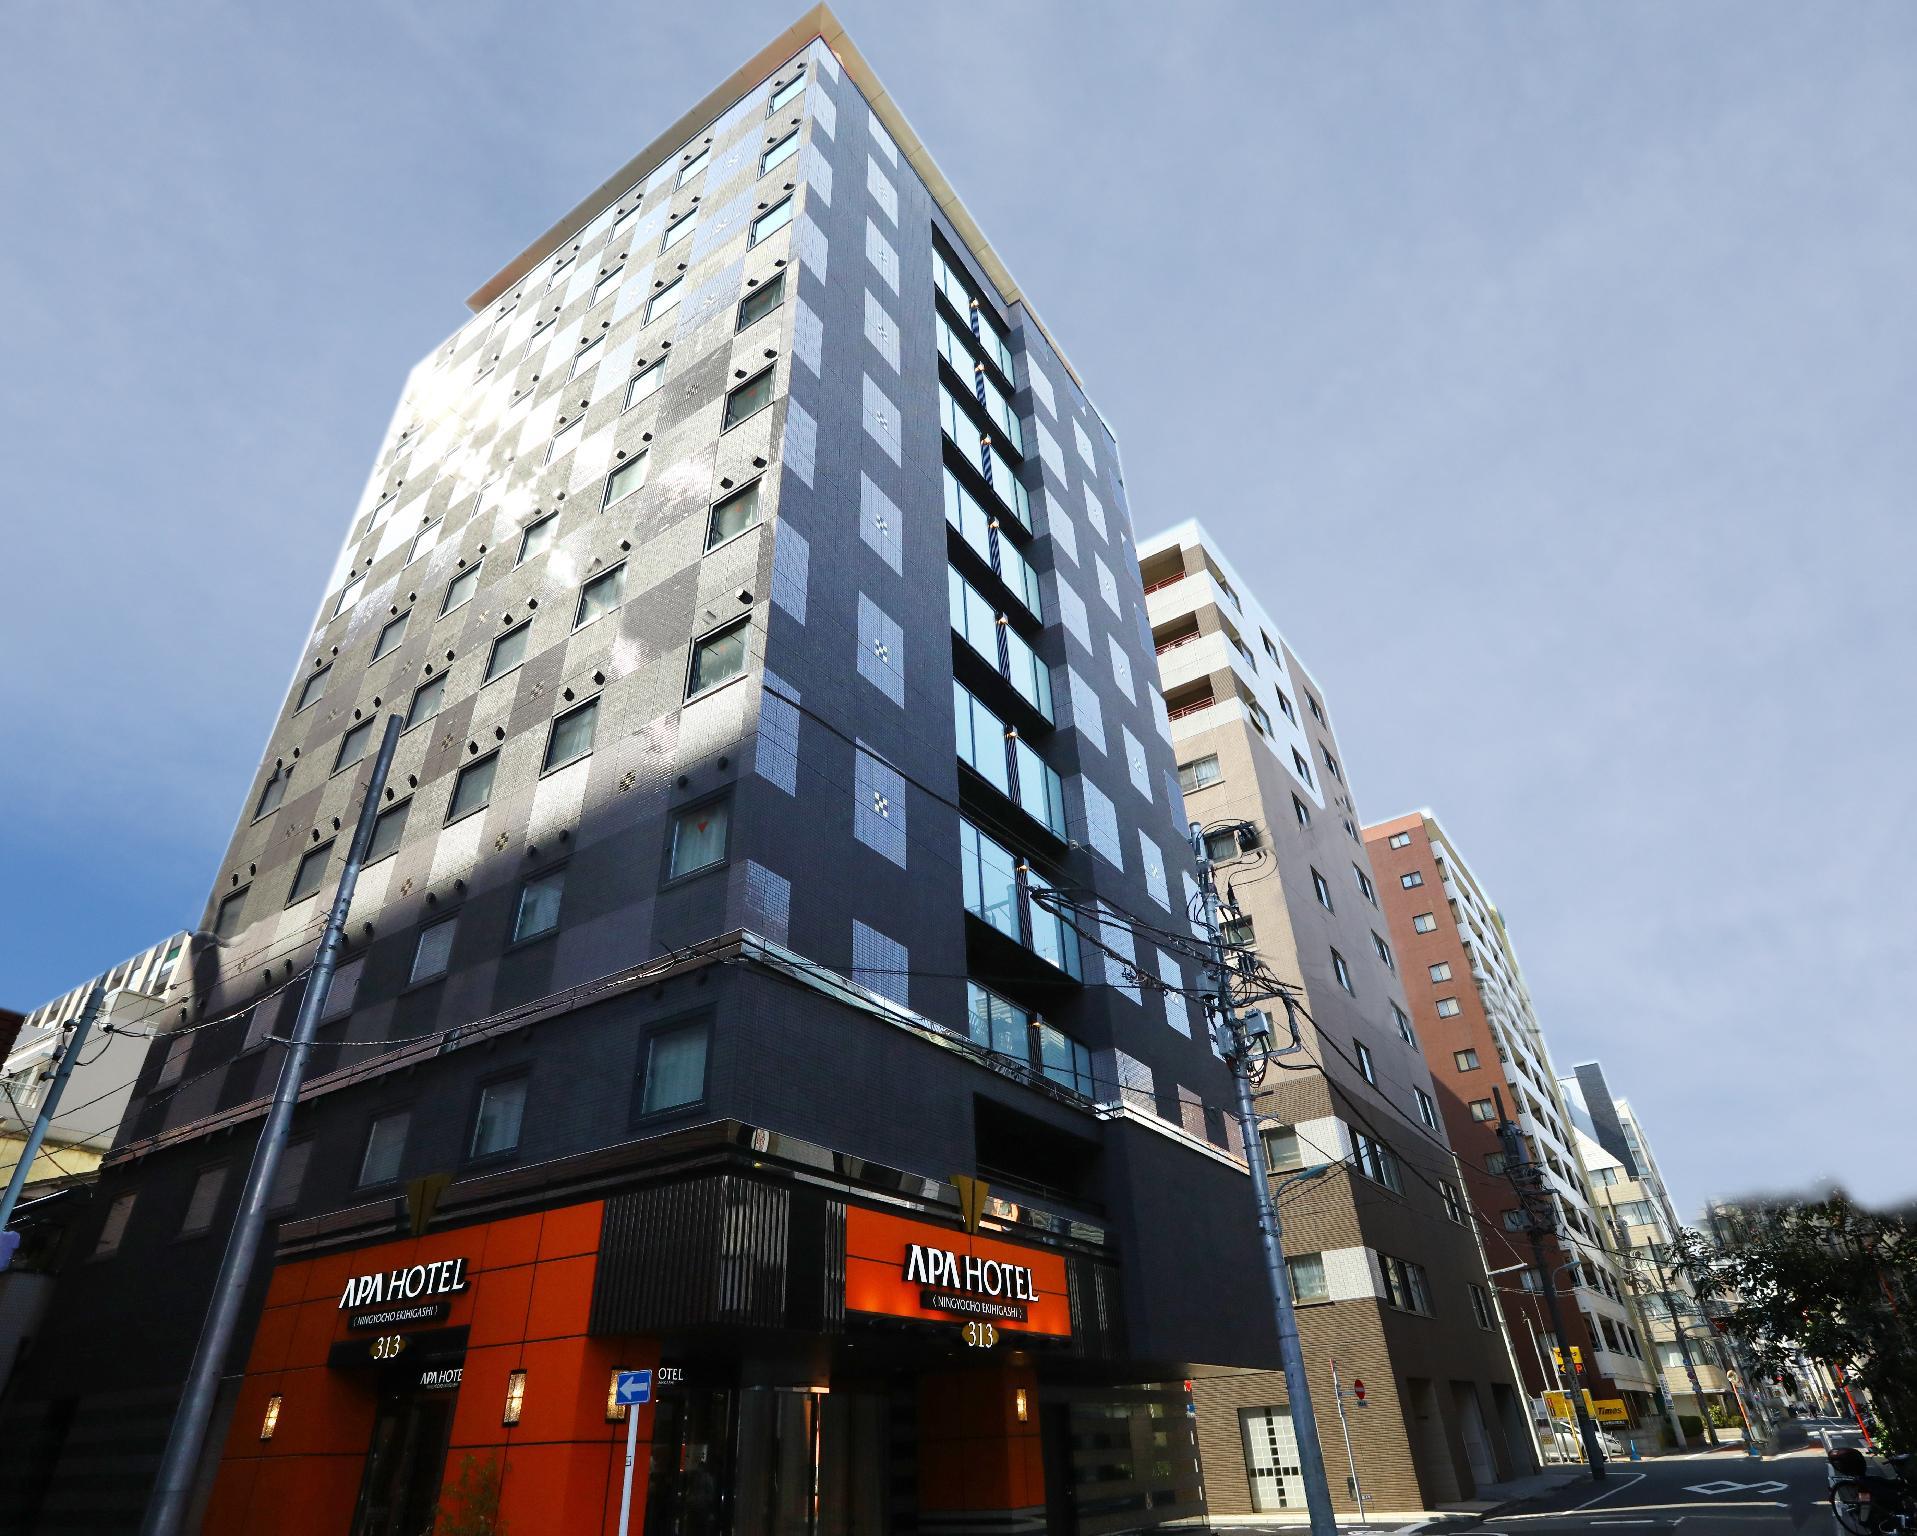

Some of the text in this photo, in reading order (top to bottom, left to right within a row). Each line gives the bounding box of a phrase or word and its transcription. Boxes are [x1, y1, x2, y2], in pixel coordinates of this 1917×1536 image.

[338, 1259, 466, 1308] APA HOTEL
[908, 1244, 1039, 1302] APA HOTEL
[373, 1334, 401, 1360] 313
[968, 1321, 994, 1349] 313
[420, 1371, 438, 1384] APA
